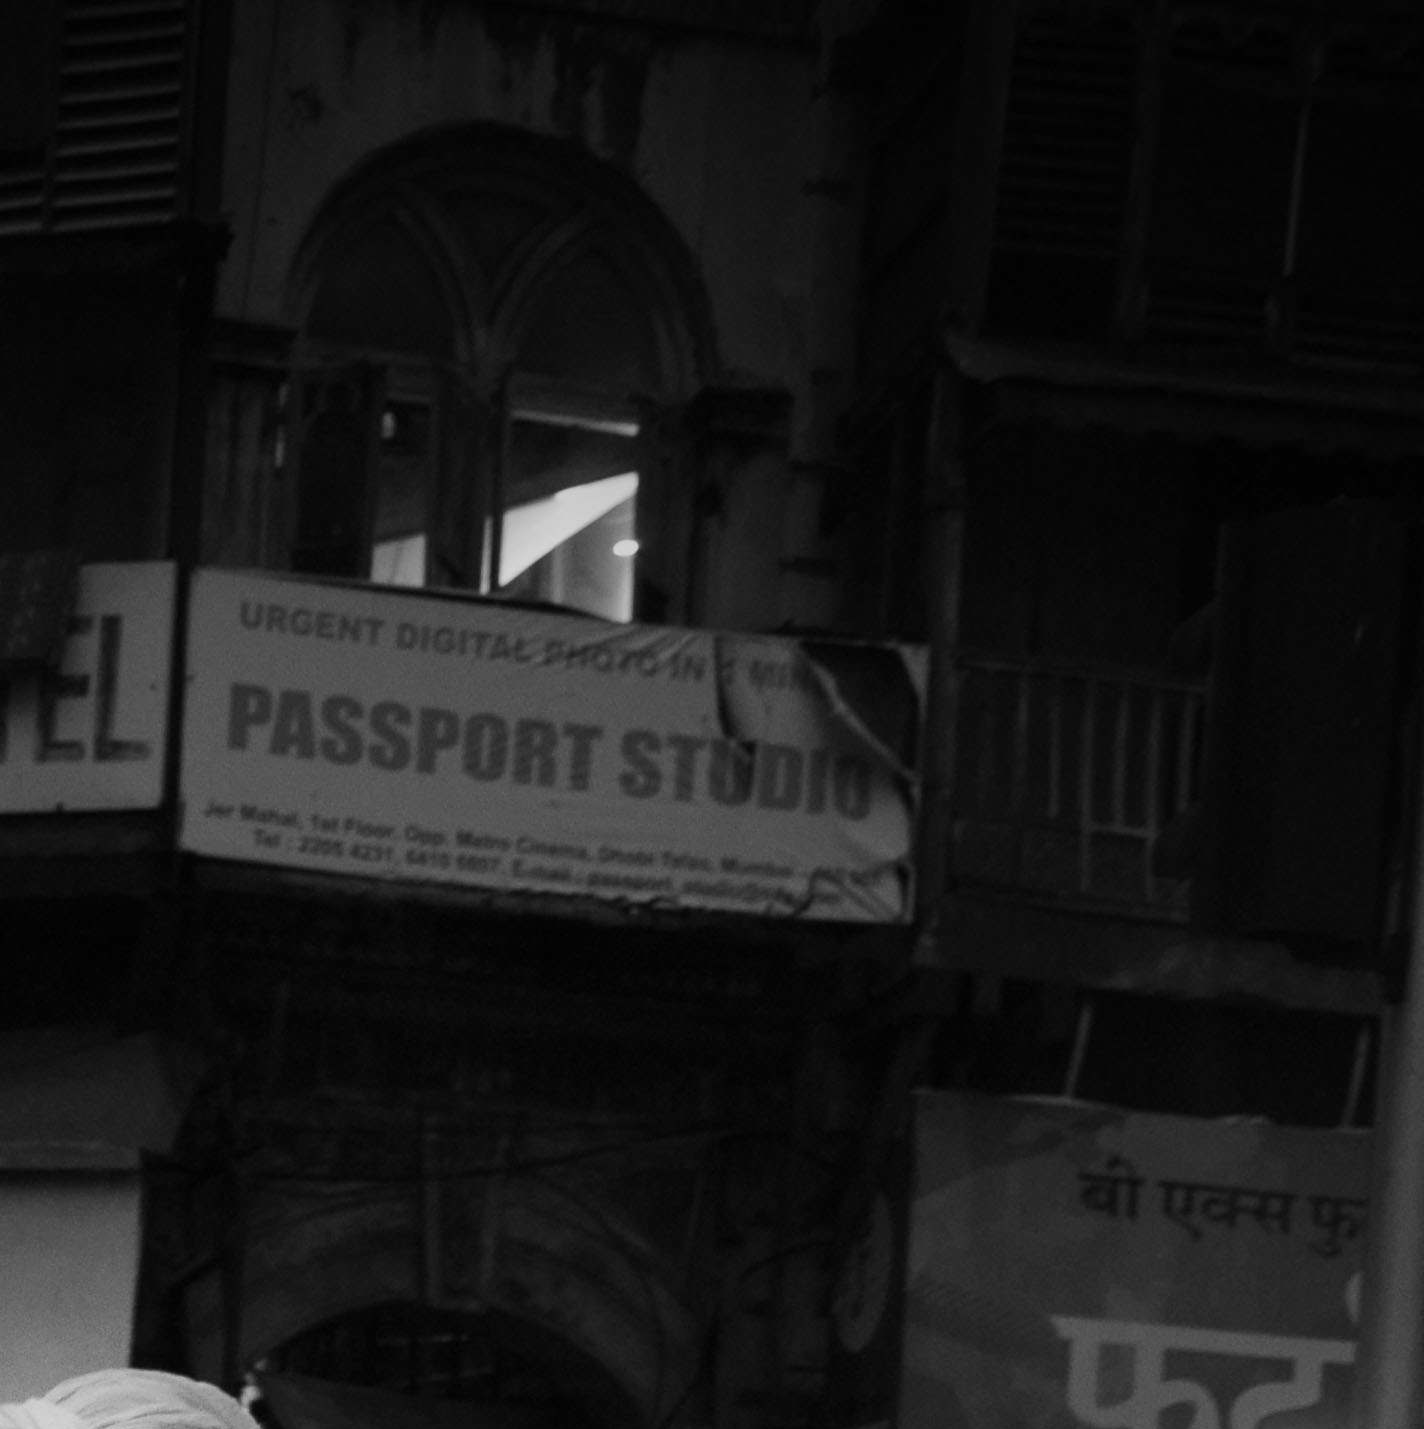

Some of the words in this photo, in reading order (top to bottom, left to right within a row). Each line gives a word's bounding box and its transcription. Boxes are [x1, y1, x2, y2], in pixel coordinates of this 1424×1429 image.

[239, 600, 385, 645] URGENT
[395, 622, 531, 664] DIGITAL
[226, 681, 604, 793] PASSPORT
[618, 728, 875, 821] STUDIO
